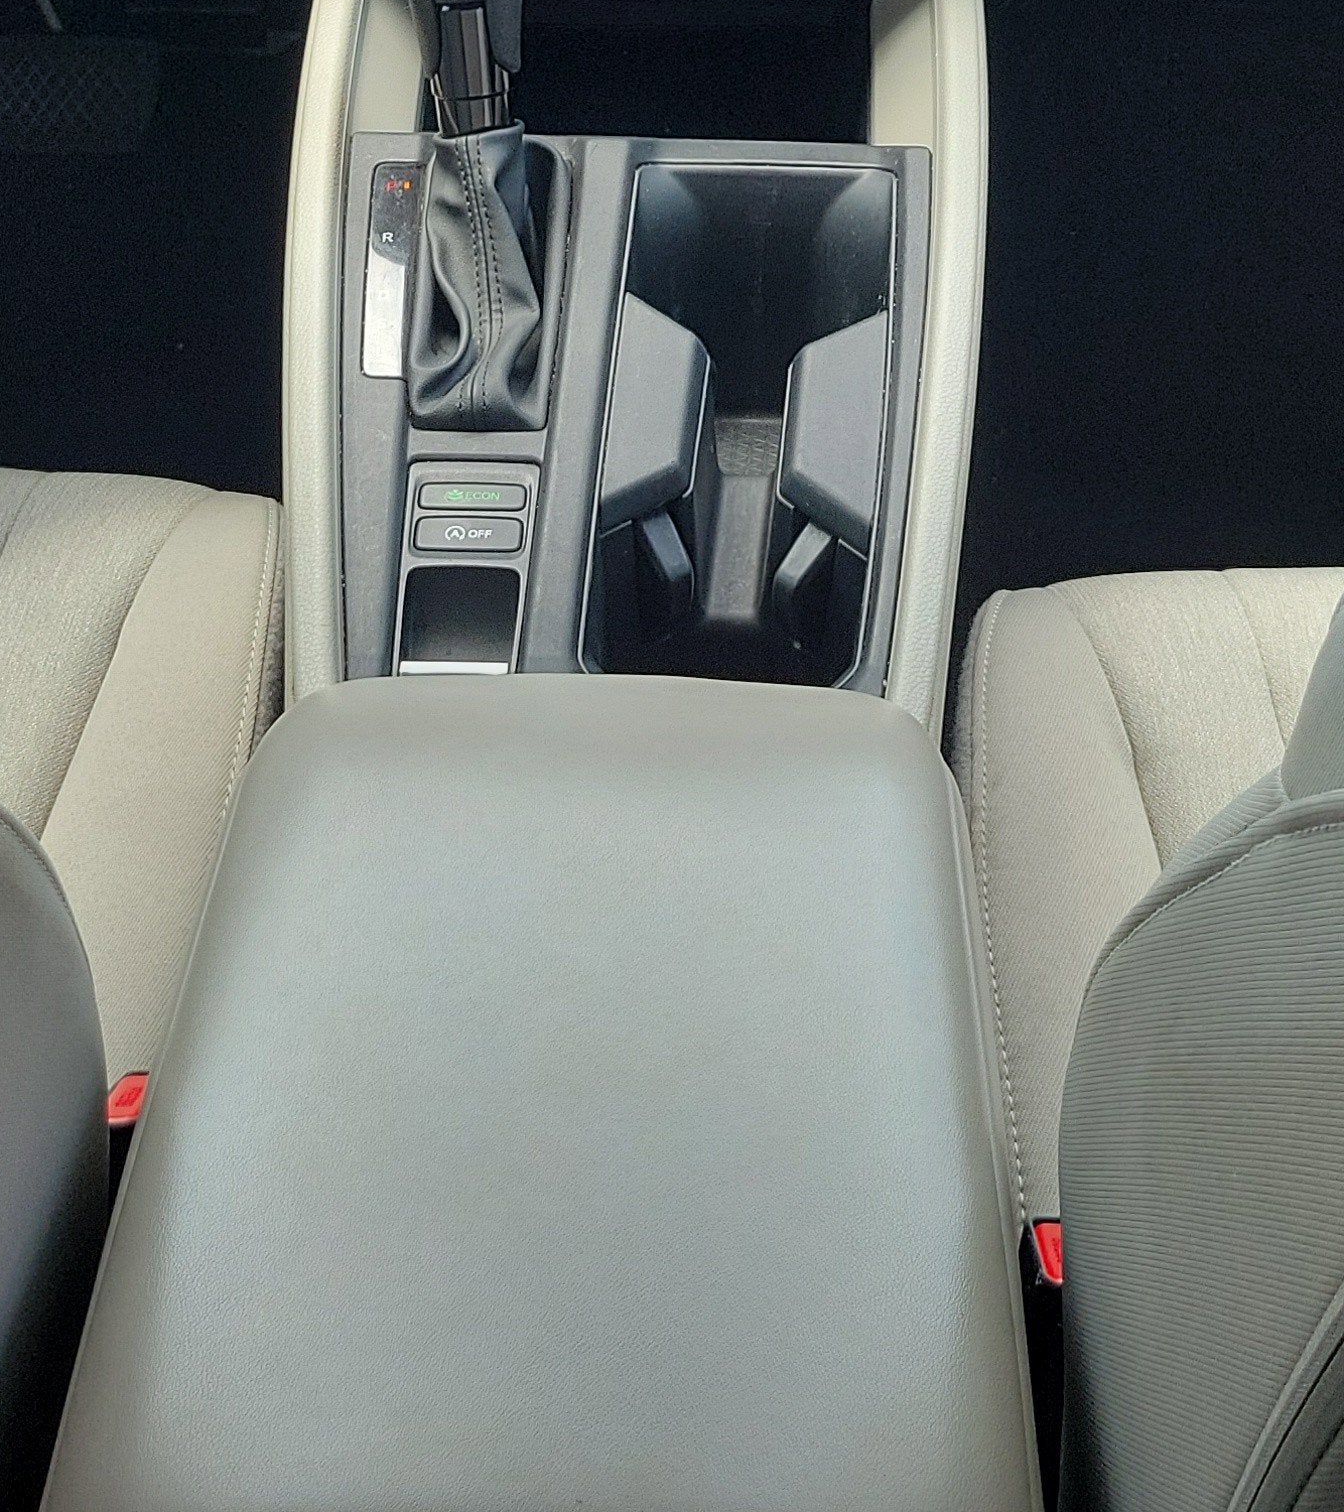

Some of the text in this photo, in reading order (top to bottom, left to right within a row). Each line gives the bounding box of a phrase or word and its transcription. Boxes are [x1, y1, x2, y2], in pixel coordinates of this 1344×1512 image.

[382, 231, 394, 243] R
[465, 491, 500, 500] ECON
[468, 529, 493, 539] OFF
